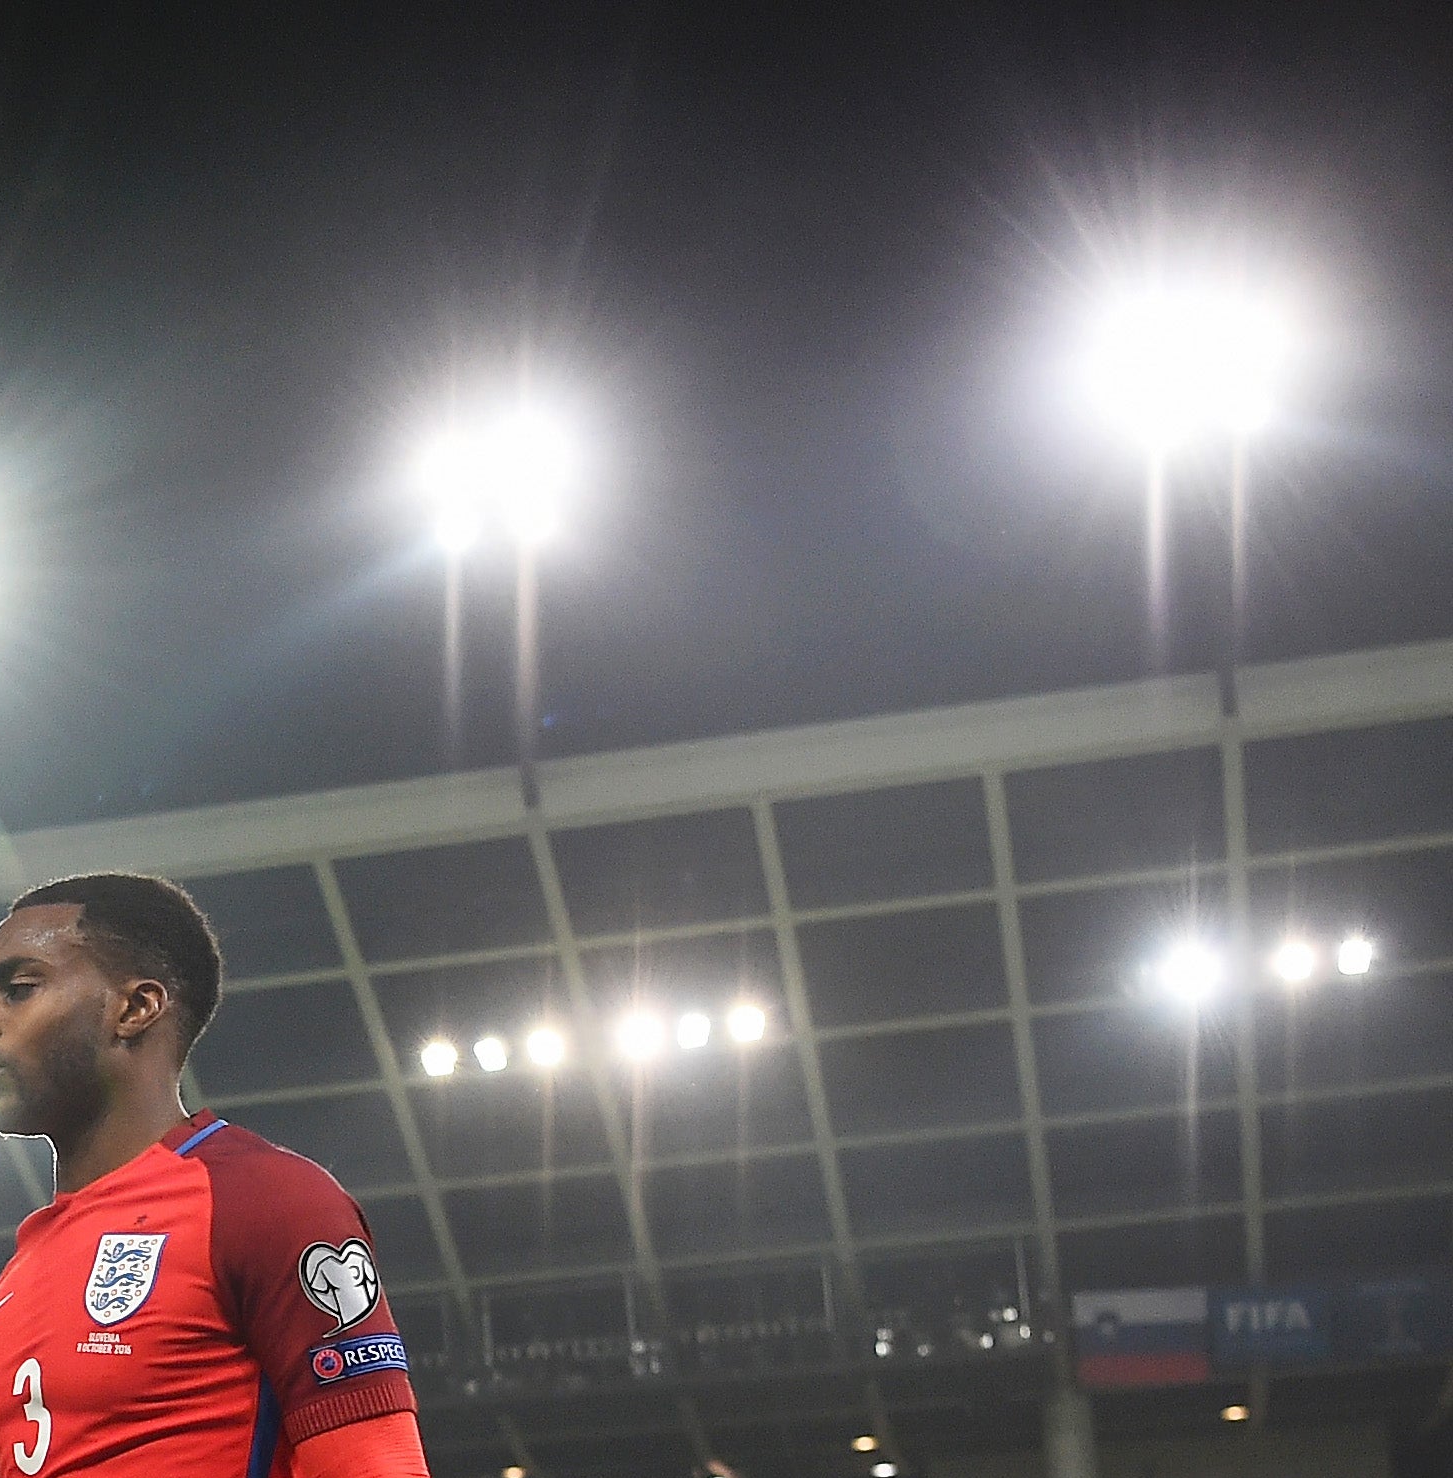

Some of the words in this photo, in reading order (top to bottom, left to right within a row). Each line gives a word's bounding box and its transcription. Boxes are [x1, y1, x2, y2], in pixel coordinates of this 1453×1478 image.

[1224, 1301, 1311, 1332] FIFA
[344, 1344, 406, 1367] RESPEC
[12, 1357, 52, 1476] 3
